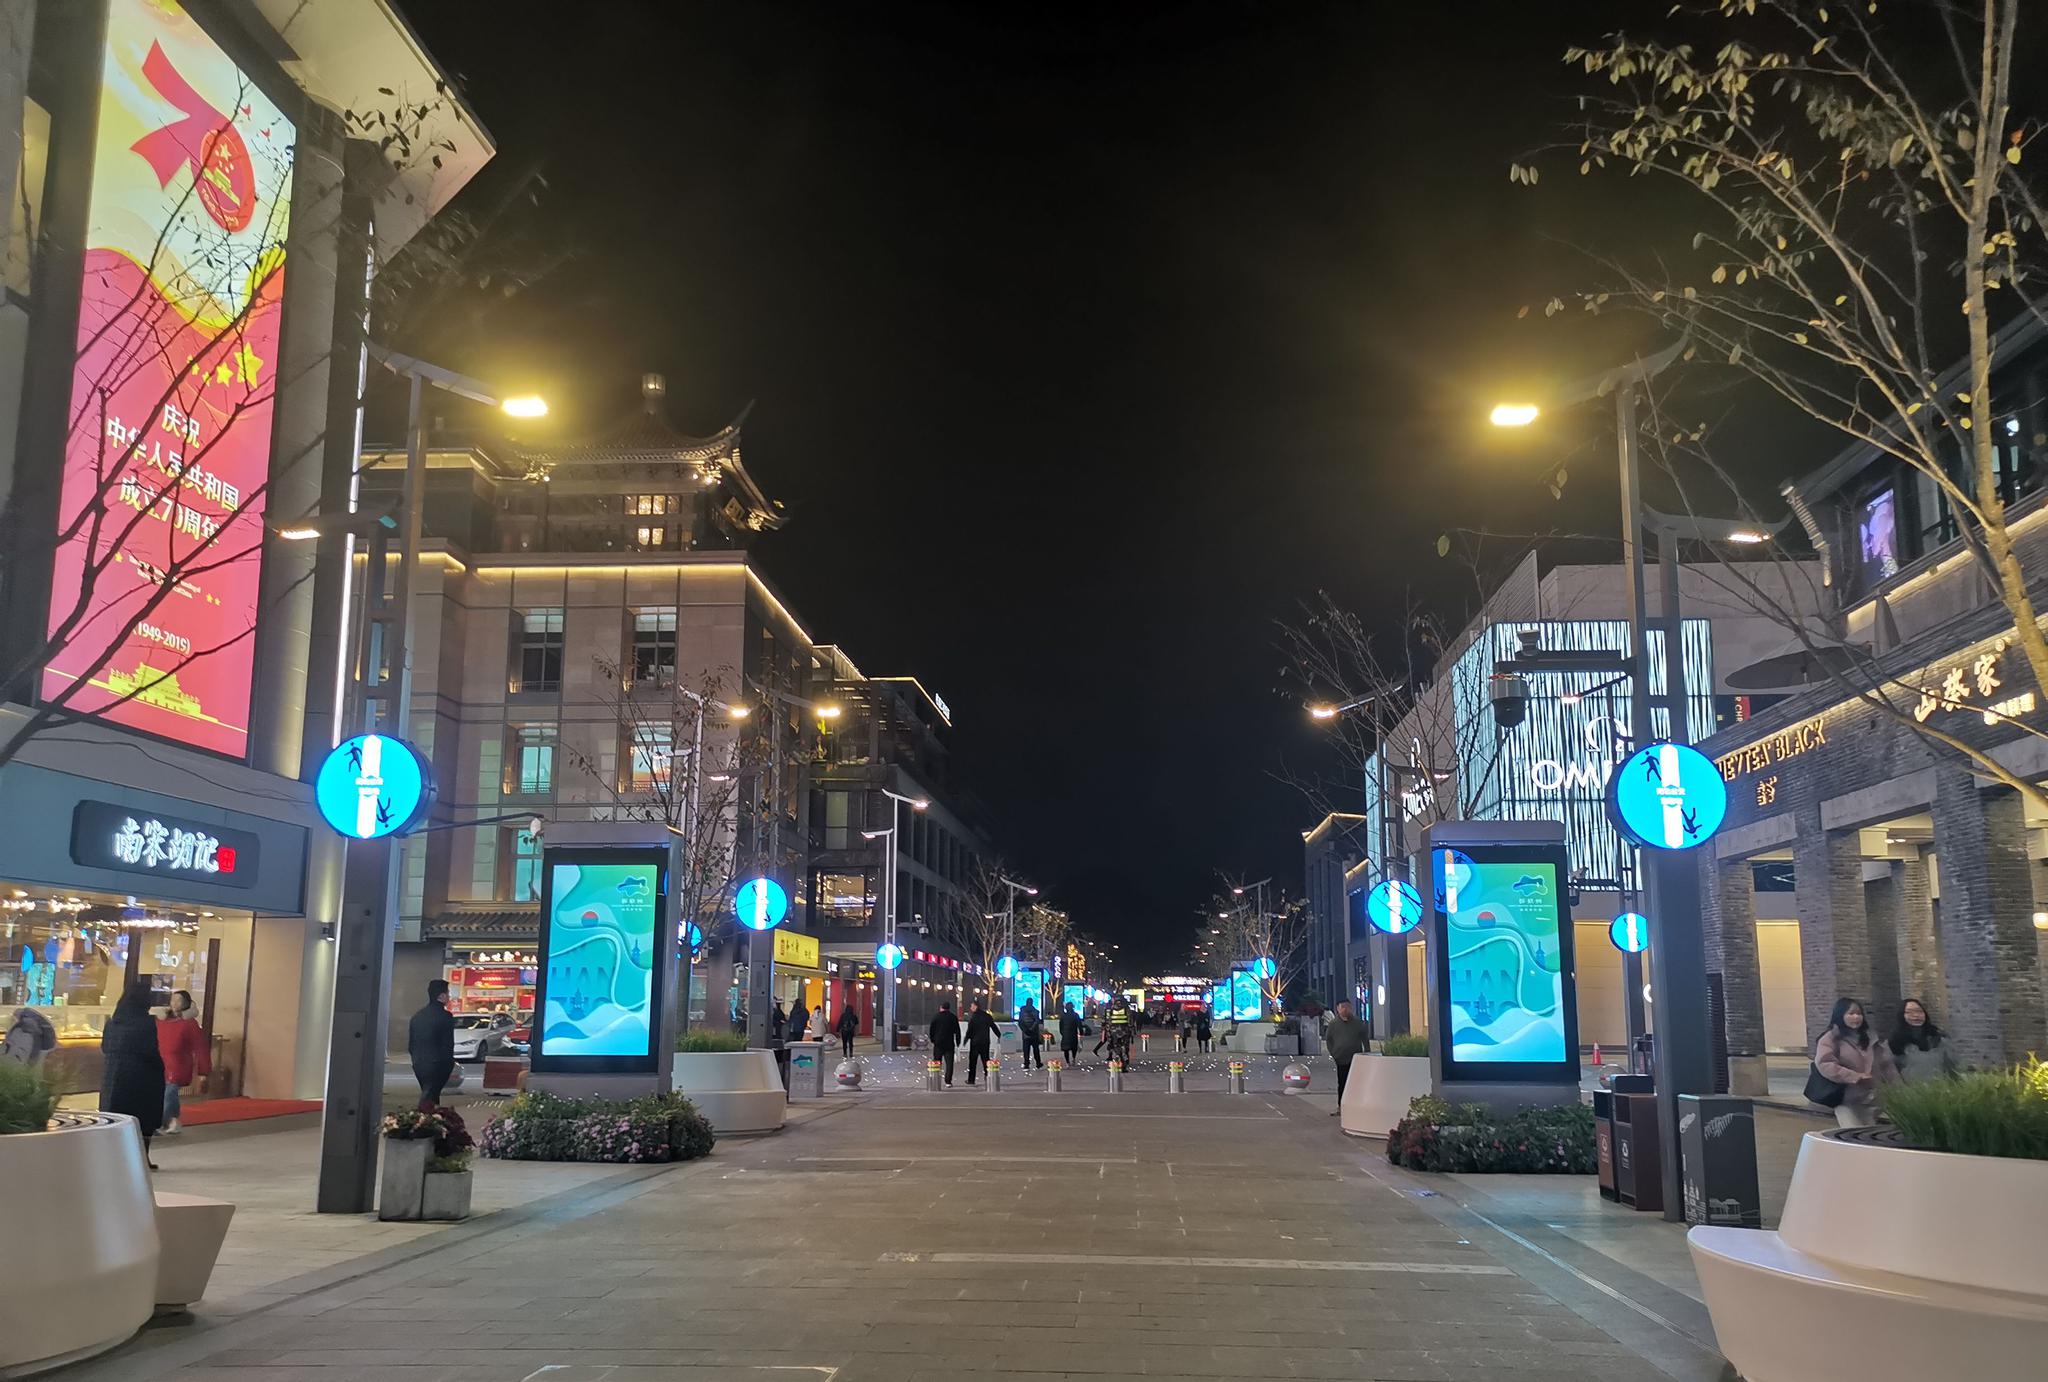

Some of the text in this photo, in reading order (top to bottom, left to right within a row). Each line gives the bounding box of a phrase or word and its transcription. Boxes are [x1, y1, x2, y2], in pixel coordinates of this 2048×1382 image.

[161, 403, 201, 449] 庆祝
[106, 415, 240, 513] 中华人民共和国
[119, 475, 221, 548] 成立70周年
[1774, 718, 1826, 762] BLACK
